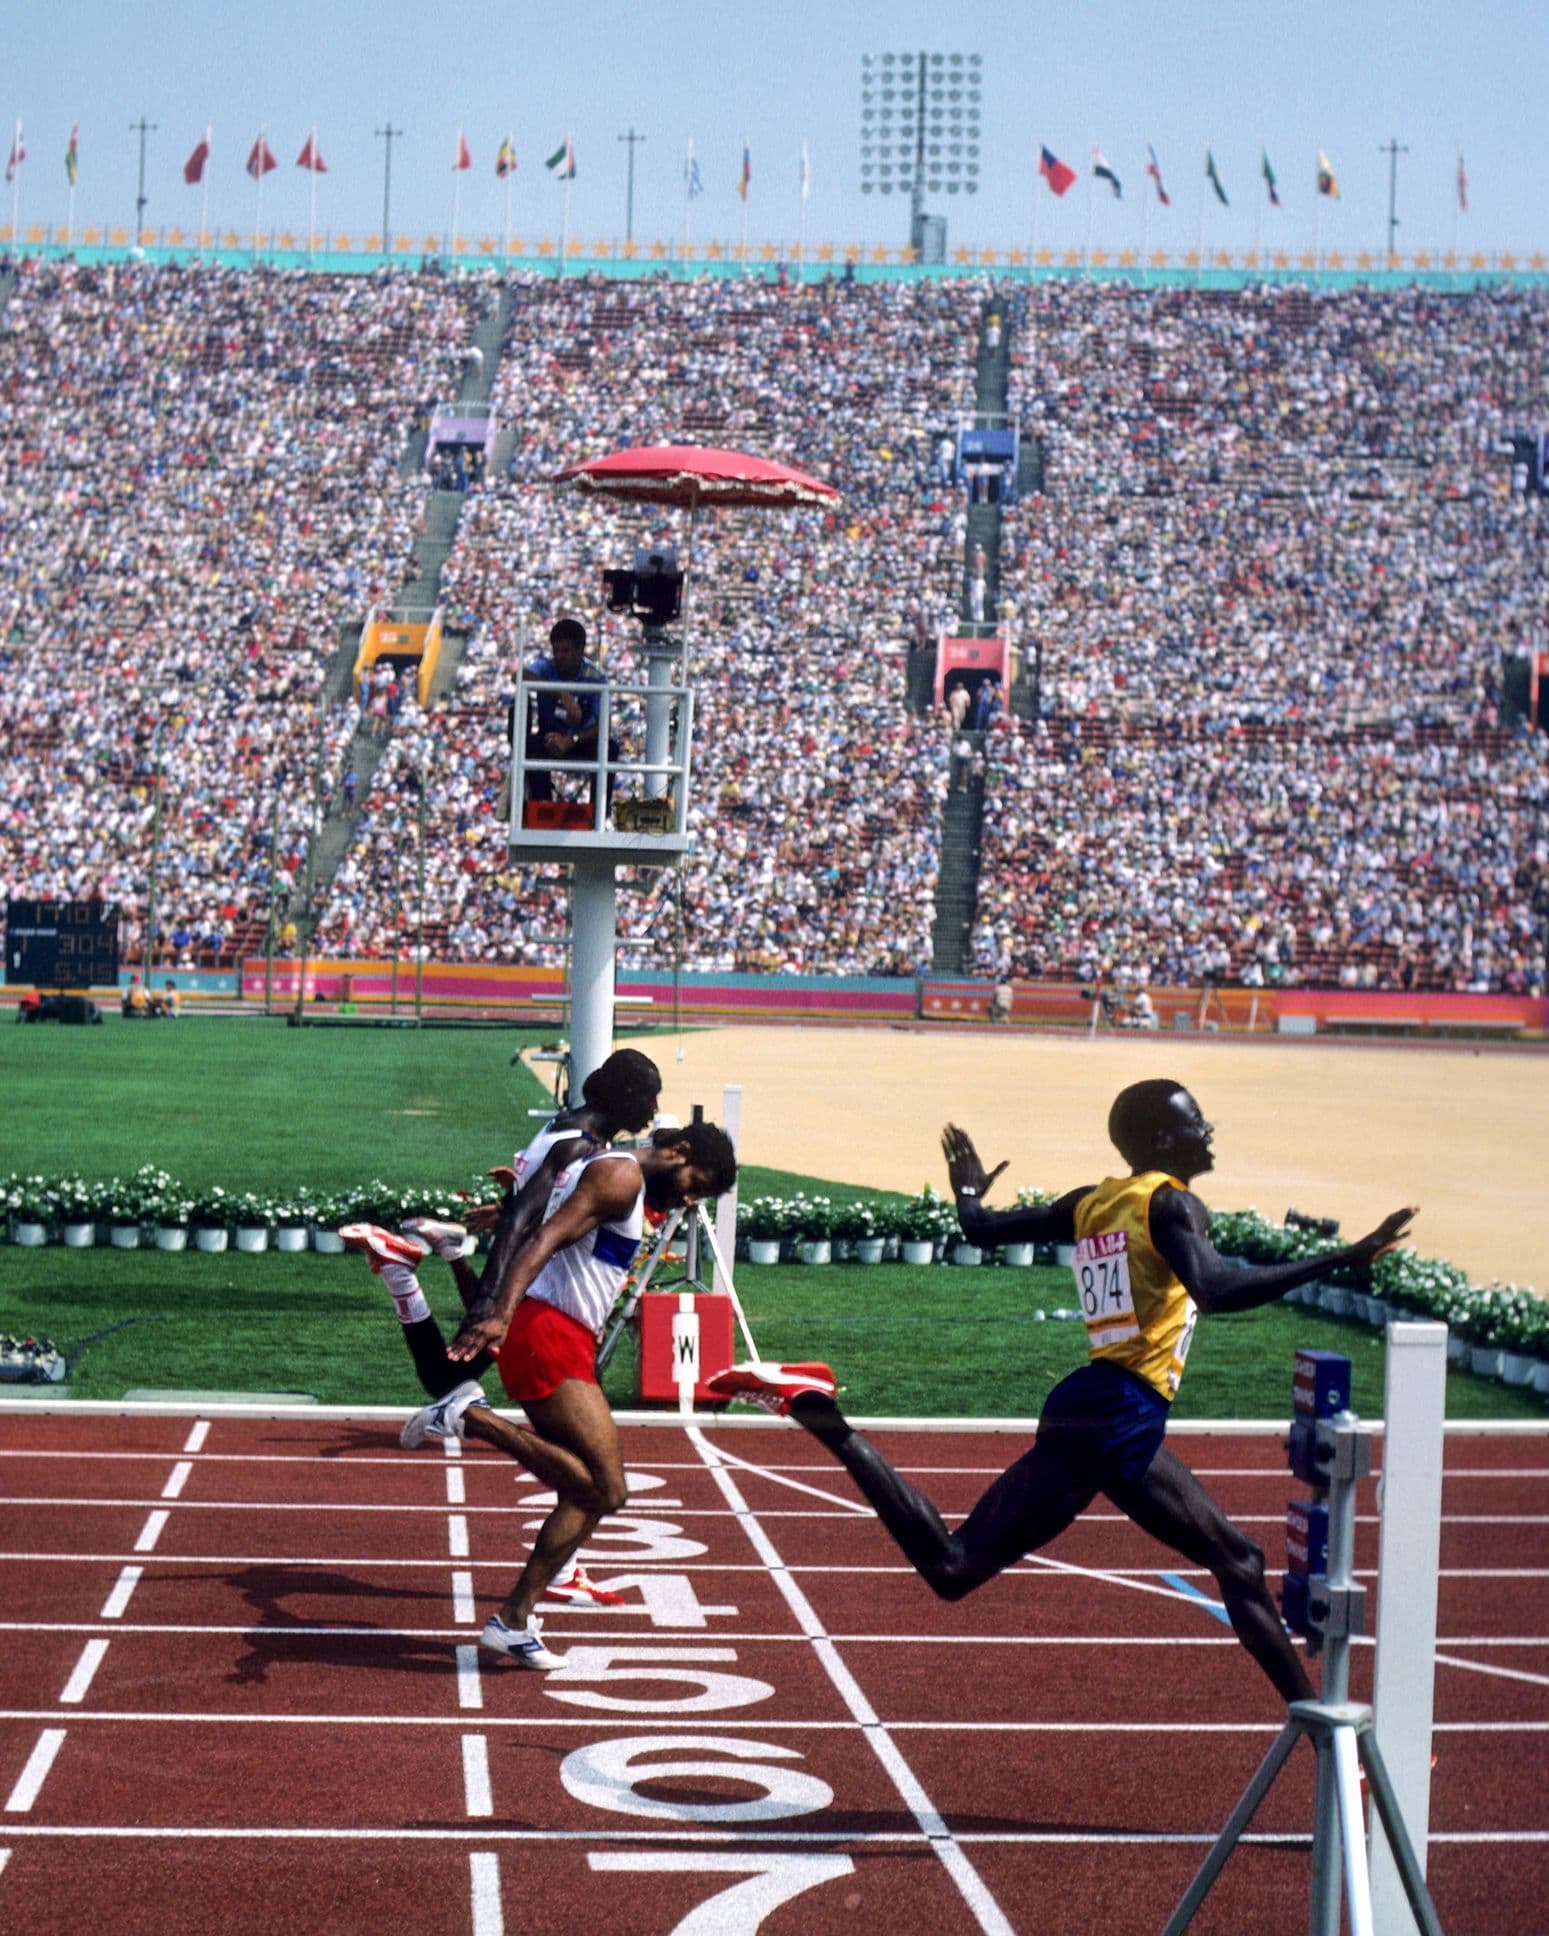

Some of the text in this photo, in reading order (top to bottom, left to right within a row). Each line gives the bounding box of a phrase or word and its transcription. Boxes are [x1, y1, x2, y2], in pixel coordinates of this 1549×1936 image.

[1081, 1260, 1123, 1316] 874
[678, 1335, 696, 1364] W
[521, 1516, 709, 1560] 3
[533, 1574, 739, 1627] 4
[542, 1646, 776, 1712] 5
[560, 1735, 834, 1822] 6
[586, 1852, 856, 1936] 7
